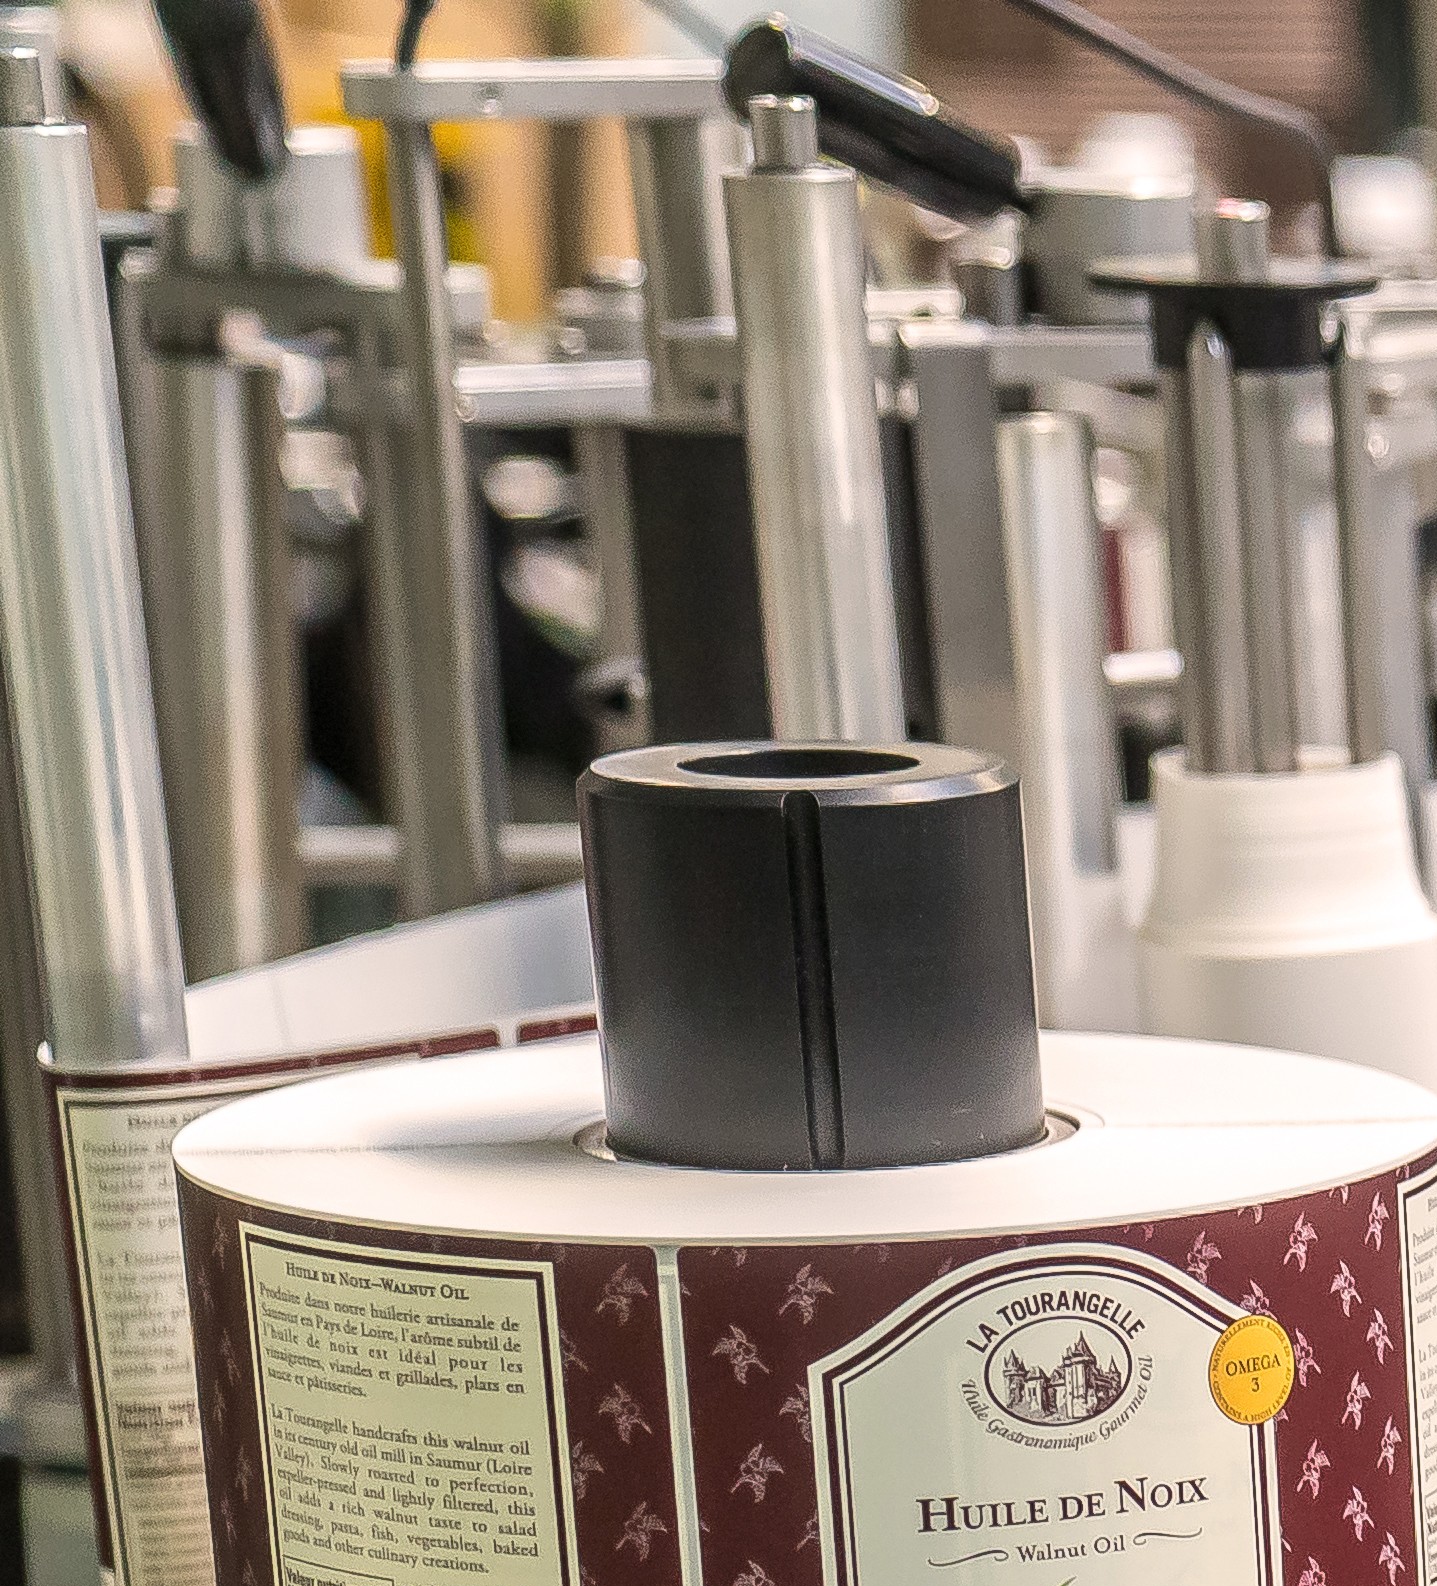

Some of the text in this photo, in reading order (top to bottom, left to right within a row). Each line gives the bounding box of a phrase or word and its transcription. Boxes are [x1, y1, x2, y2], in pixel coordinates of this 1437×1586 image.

[305, 1292, 329, 1310] dans
[334, 1302, 365, 1316] notre
[370, 1303, 421, 1323] huilerie
[426, 1313, 494, 1330] artisanale
[501, 1316, 519, 1331] de
[440, 1284, 469, 1300] OIL
[301, 1316, 313, 1327] en
[316, 1314, 341, 1337] Pays
[343, 1320, 357, 1335] de
[360, 1322, 398, 1343] Loire,
[402, 1327, 454, 1347] l'arôme
[457, 1335, 500, 1351] subtil
[503, 1337, 521, 1353] de
[965, 1290, 1146, 1354] LA TOURANGELLE
[307, 1333, 320, 1349] de
[330, 1341, 358, 1356] noix
[399, 1348, 436, 1365] idéal
[449, 1357, 488, 1372] pour
[500, 1356, 523, 1373] les
[1225, 1353, 1281, 1376] OMEGA
[295, 1374, 304, 1386] et
[329, 1359, 373, 1378] viandes
[379, 1369, 390, 1380] et
[396, 1370, 458, 1389] grillades,
[465, 1375, 500, 1394] plats
[506, 1383, 525, 1394] en
[1251, 1377, 1260, 1392] 3
[961, 1354, 1154, 1451] Huile Gastronomique Gourmet Oil
[271, 1402, 530, 1455] La Tourangelle handcrafts this walnut oil
[298, 1434, 337, 1455] century
[340, 1440, 358, 1456] old
[362, 1445, 377, 1459] oil
[381, 1448, 406, 1463] mill
[410, 1452, 423, 1466] in
[427, 1453, 482, 1472] Saumur
[486, 1458, 533, 1475] (Loire
[278, 1467, 536, 1517] expeller-pressed and lightly filtered, this
[321, 1455, 359, 1480] Slowly
[368, 1468, 416, 1485] roasted
[425, 1476, 439, 1487] to
[449, 1477, 534, 1497] perfection,
[279, 1487, 292, 1501] oil
[342, 1501, 365, 1517] rich
[373, 1507, 419, 1526] walnut
[429, 1516, 462, 1531] taste
[472, 1521, 488, 1533] to
[498, 1521, 537, 1537] salad
[915, 1476, 1209, 1533] HUILE DE NOIX
[282, 1505, 539, 1557] dressing, pasta, fish, vegetables, baked
[1016, 1534, 1126, 1562] Walnut Oil
[313, 1535, 332, 1551] and
[335, 1540, 364, 1556] other
[368, 1547, 418, 1568] culinary
[422, 1556, 490, 1573] creations.
